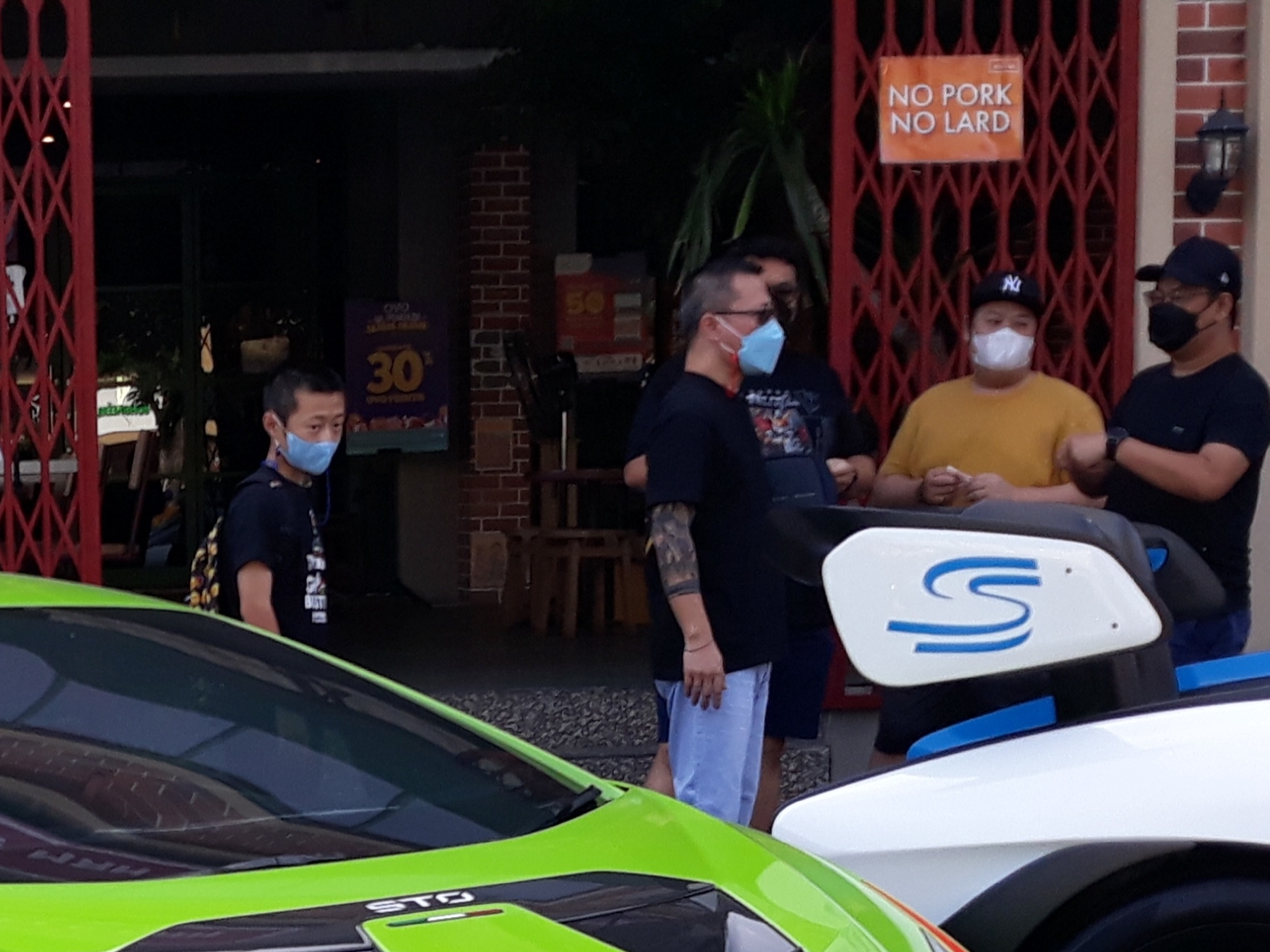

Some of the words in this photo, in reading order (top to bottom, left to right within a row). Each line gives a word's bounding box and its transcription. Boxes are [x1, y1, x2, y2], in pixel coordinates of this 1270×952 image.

[889, 83, 933, 107] NO
[942, 82, 1013, 106] PORK
[891, 110, 936, 134] NO
[945, 110, 1011, 133] LARD
[365, 891, 475, 914] STO
